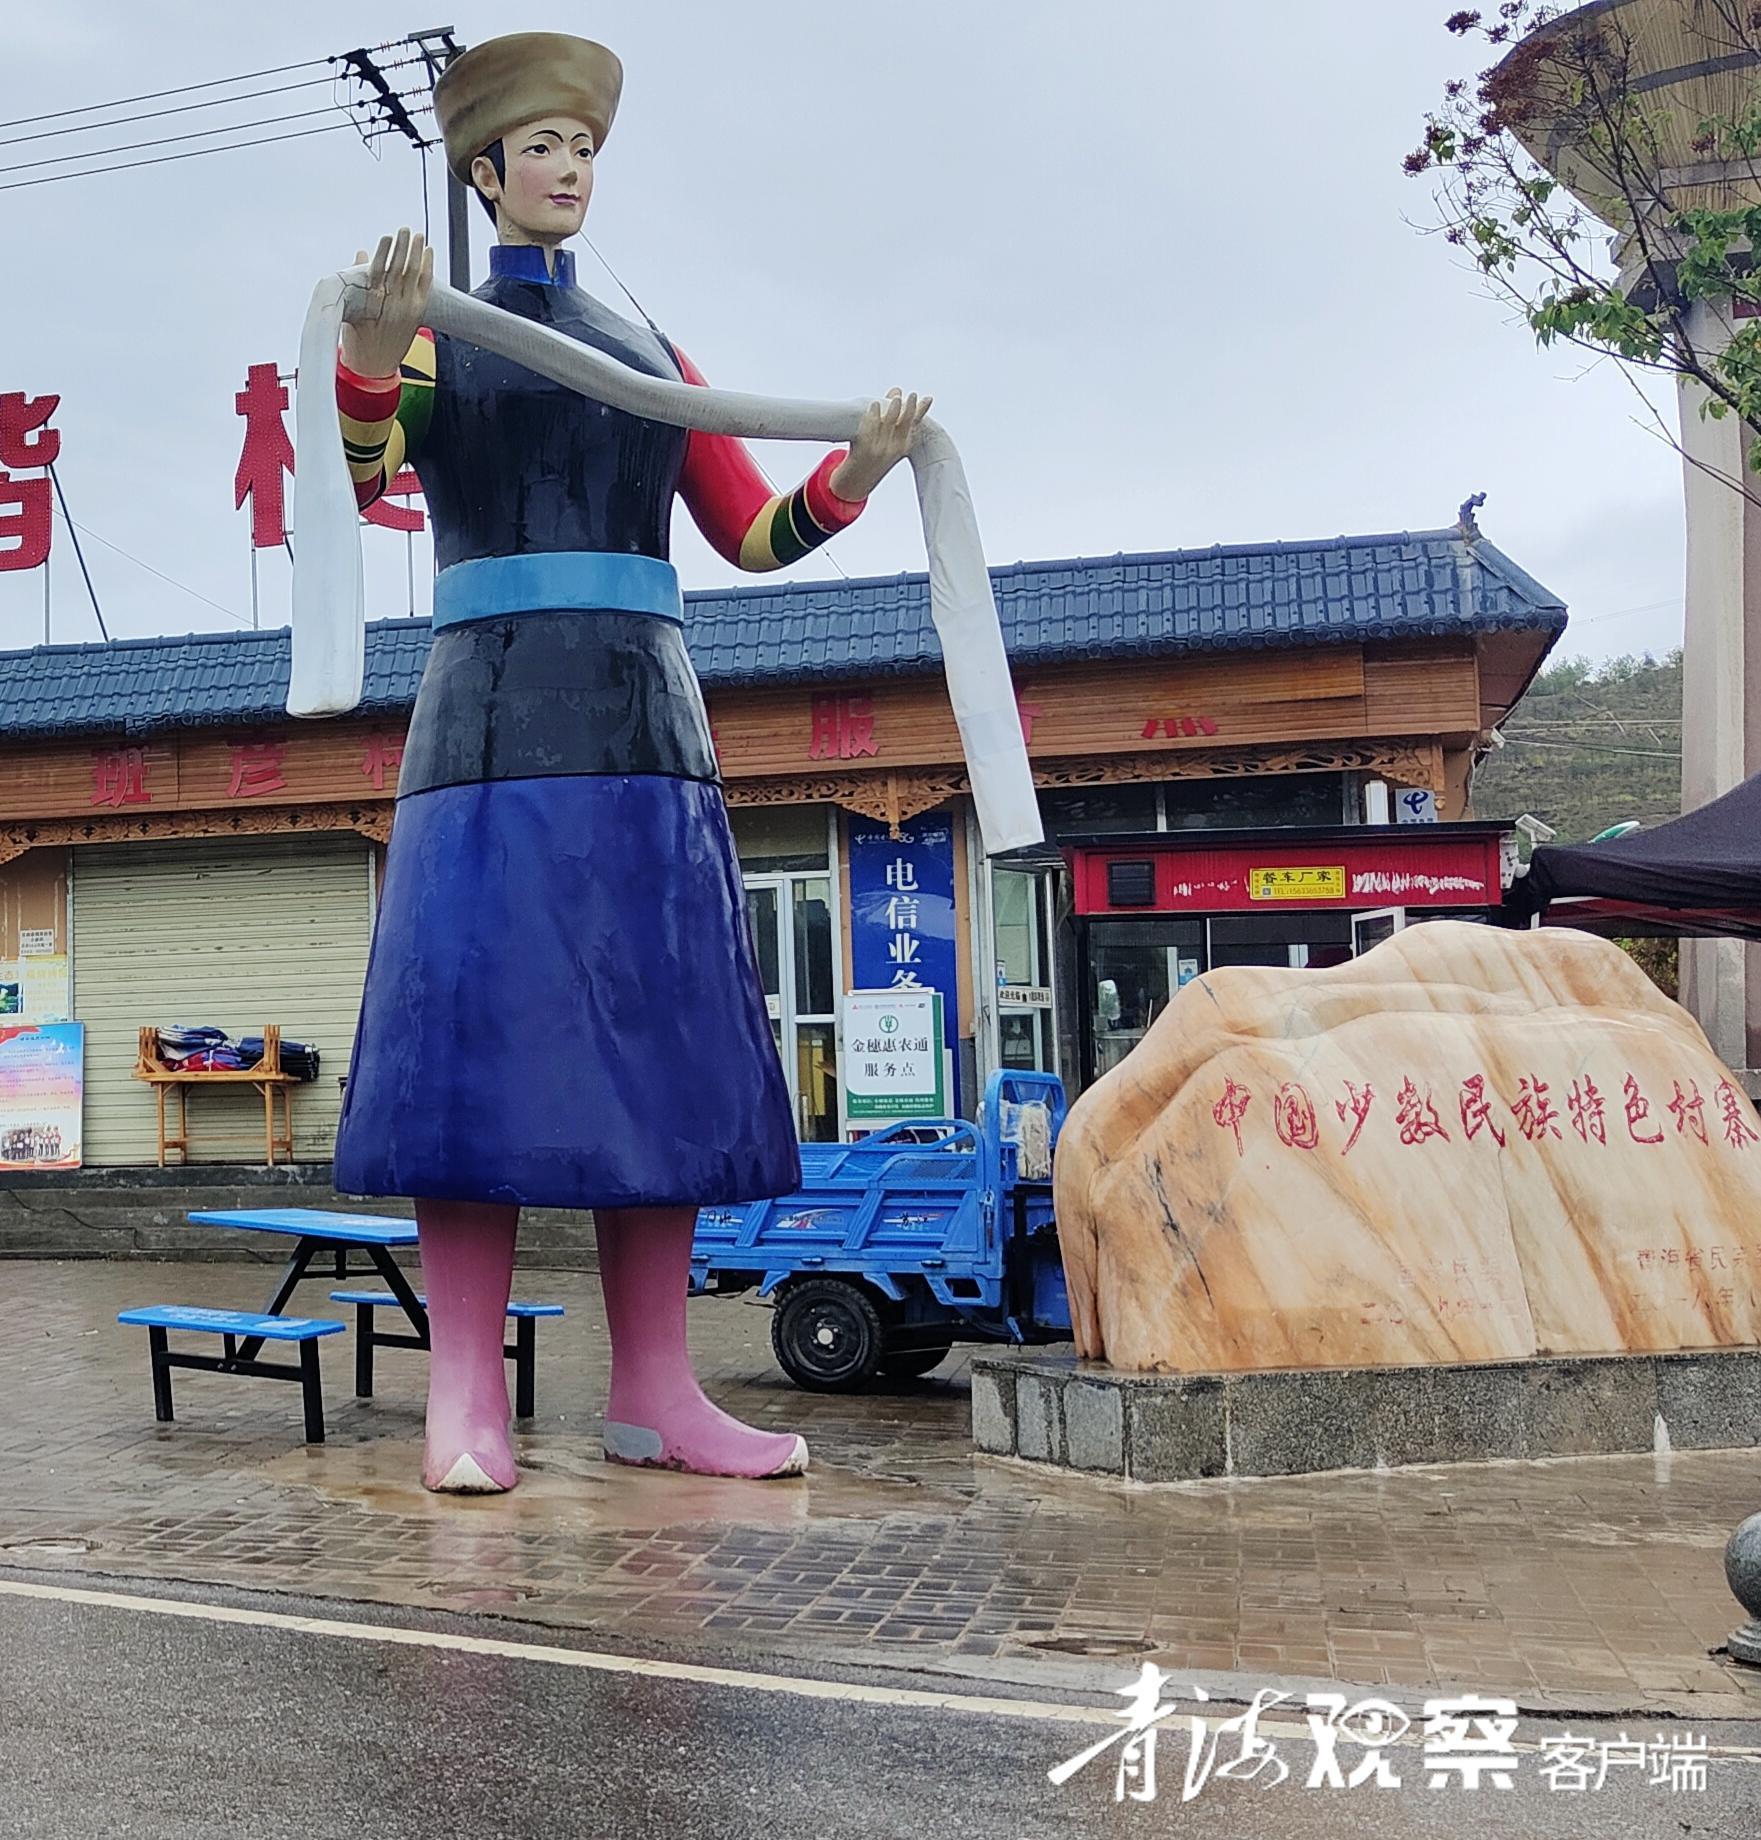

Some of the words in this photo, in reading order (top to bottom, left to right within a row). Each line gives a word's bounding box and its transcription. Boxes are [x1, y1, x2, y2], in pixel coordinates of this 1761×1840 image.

[851, 1037, 929, 1053] 金穗惠农通
[864, 1062, 916, 1077] 服务点
[1213, 1072, 1760, 1157] 中国少数民族特色村寨
